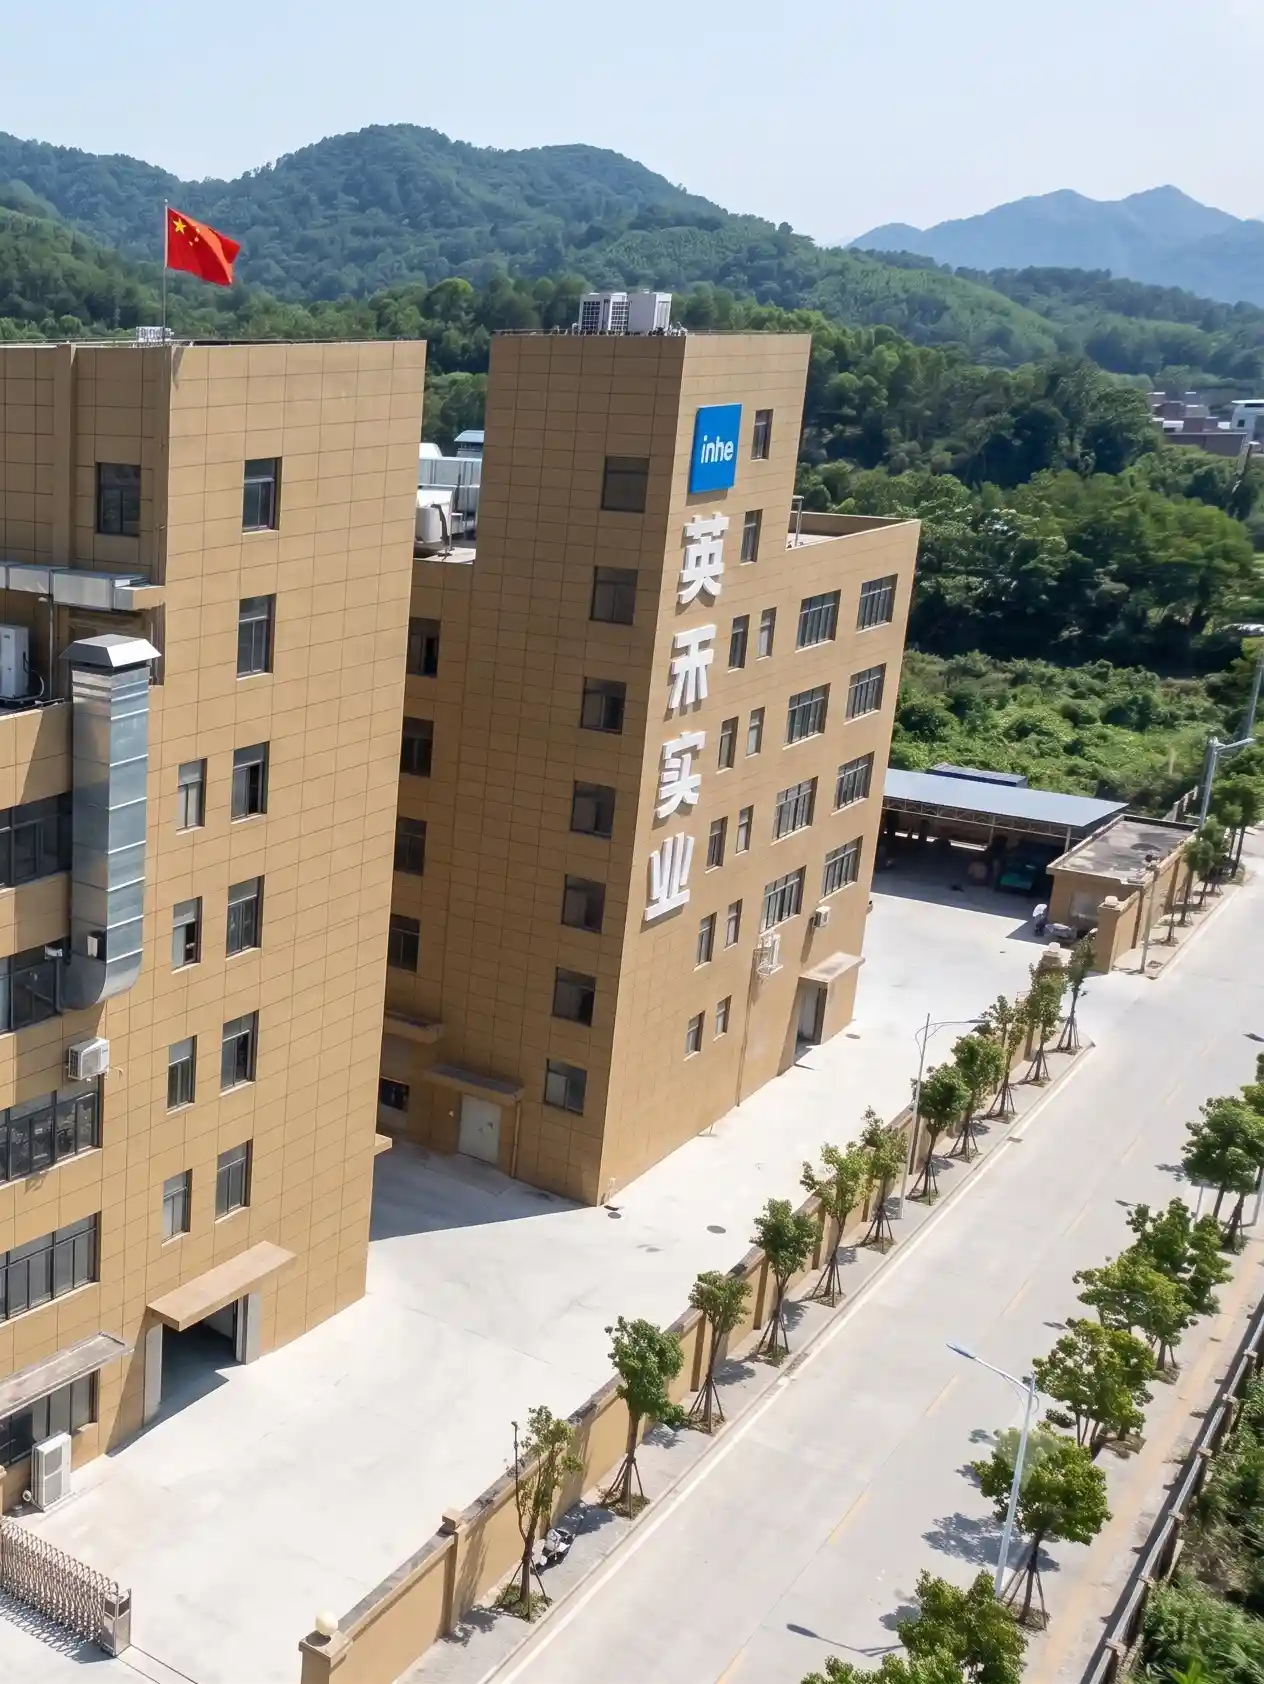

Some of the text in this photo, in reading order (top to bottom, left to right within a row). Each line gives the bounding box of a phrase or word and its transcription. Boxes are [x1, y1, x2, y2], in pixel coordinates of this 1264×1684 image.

[700, 434, 734, 464] inhe
[643, 511, 730, 922] 英禾实业
